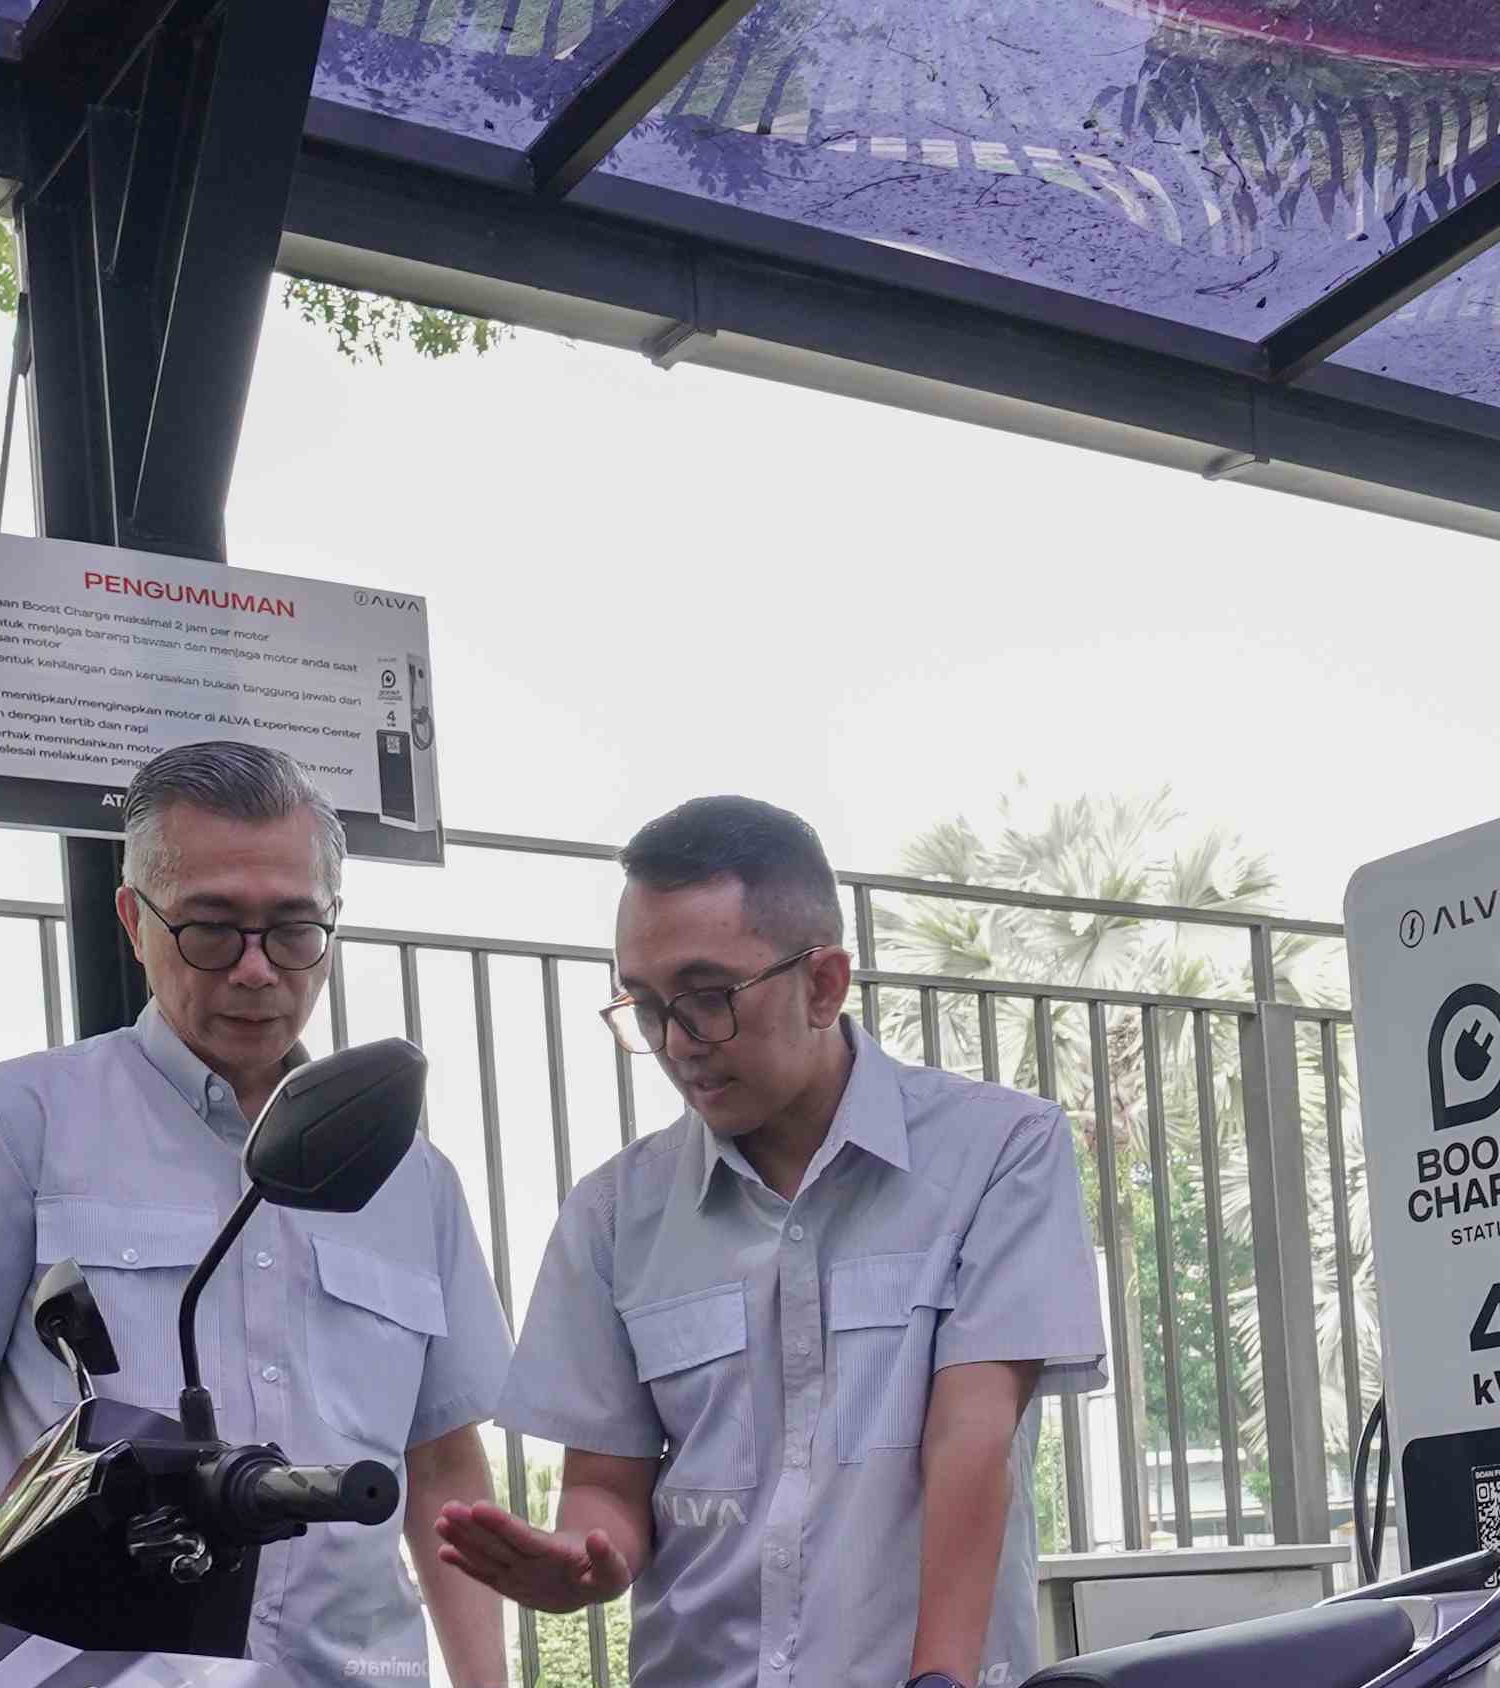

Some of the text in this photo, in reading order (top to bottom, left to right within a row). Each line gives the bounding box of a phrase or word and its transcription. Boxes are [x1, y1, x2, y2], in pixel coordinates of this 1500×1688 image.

[83, 571, 295, 618] PENGUMUMAN
[370, 594, 421, 613] ALVA
[22, 600, 61, 615] Boost
[63, 605, 111, 622] Charge
[113, 612, 173, 631] maksimal
[175, 620, 183, 631] 2
[185, 622, 207, 635] jam
[210, 626, 230, 639] per
[234, 628, 270, 642] motor
[22, 635, 62, 650] motor
[27, 621, 83, 640] menjaga
[85, 628, 130, 646] barang
[132, 633, 182, 650] bawaan
[184, 640, 207, 653] dan
[209, 645, 261, 662] menjaga
[263, 651, 299, 666] motor
[301, 657, 331, 670] anda
[332, 662, 359, 674] saat
[37, 656, 106, 677] kehilangan
[109, 664, 133, 679] dan
[135, 669, 200, 688] kerusakan
[202, 677, 241, 692] bukan
[243, 682, 300, 701] tanggung
[302, 690, 337, 706] jawab
[338, 694, 363, 707] dari
[7, 709, 57, 726] dengan
[59, 713, 95, 730] tertib
[97, 719, 122, 732] dan
[124, 722, 150, 737] rapi
[164, 708, 202, 722] motor
[204, 710, 216, 723] di
[217, 713, 252, 728] ALVA
[253, 718, 321, 736] Experience
[321, 726, 363, 741] Center
[34, 732, 124, 752] memindahkan
[318, 763, 354, 777] motor
[38, 748, 109, 765] melakukan
